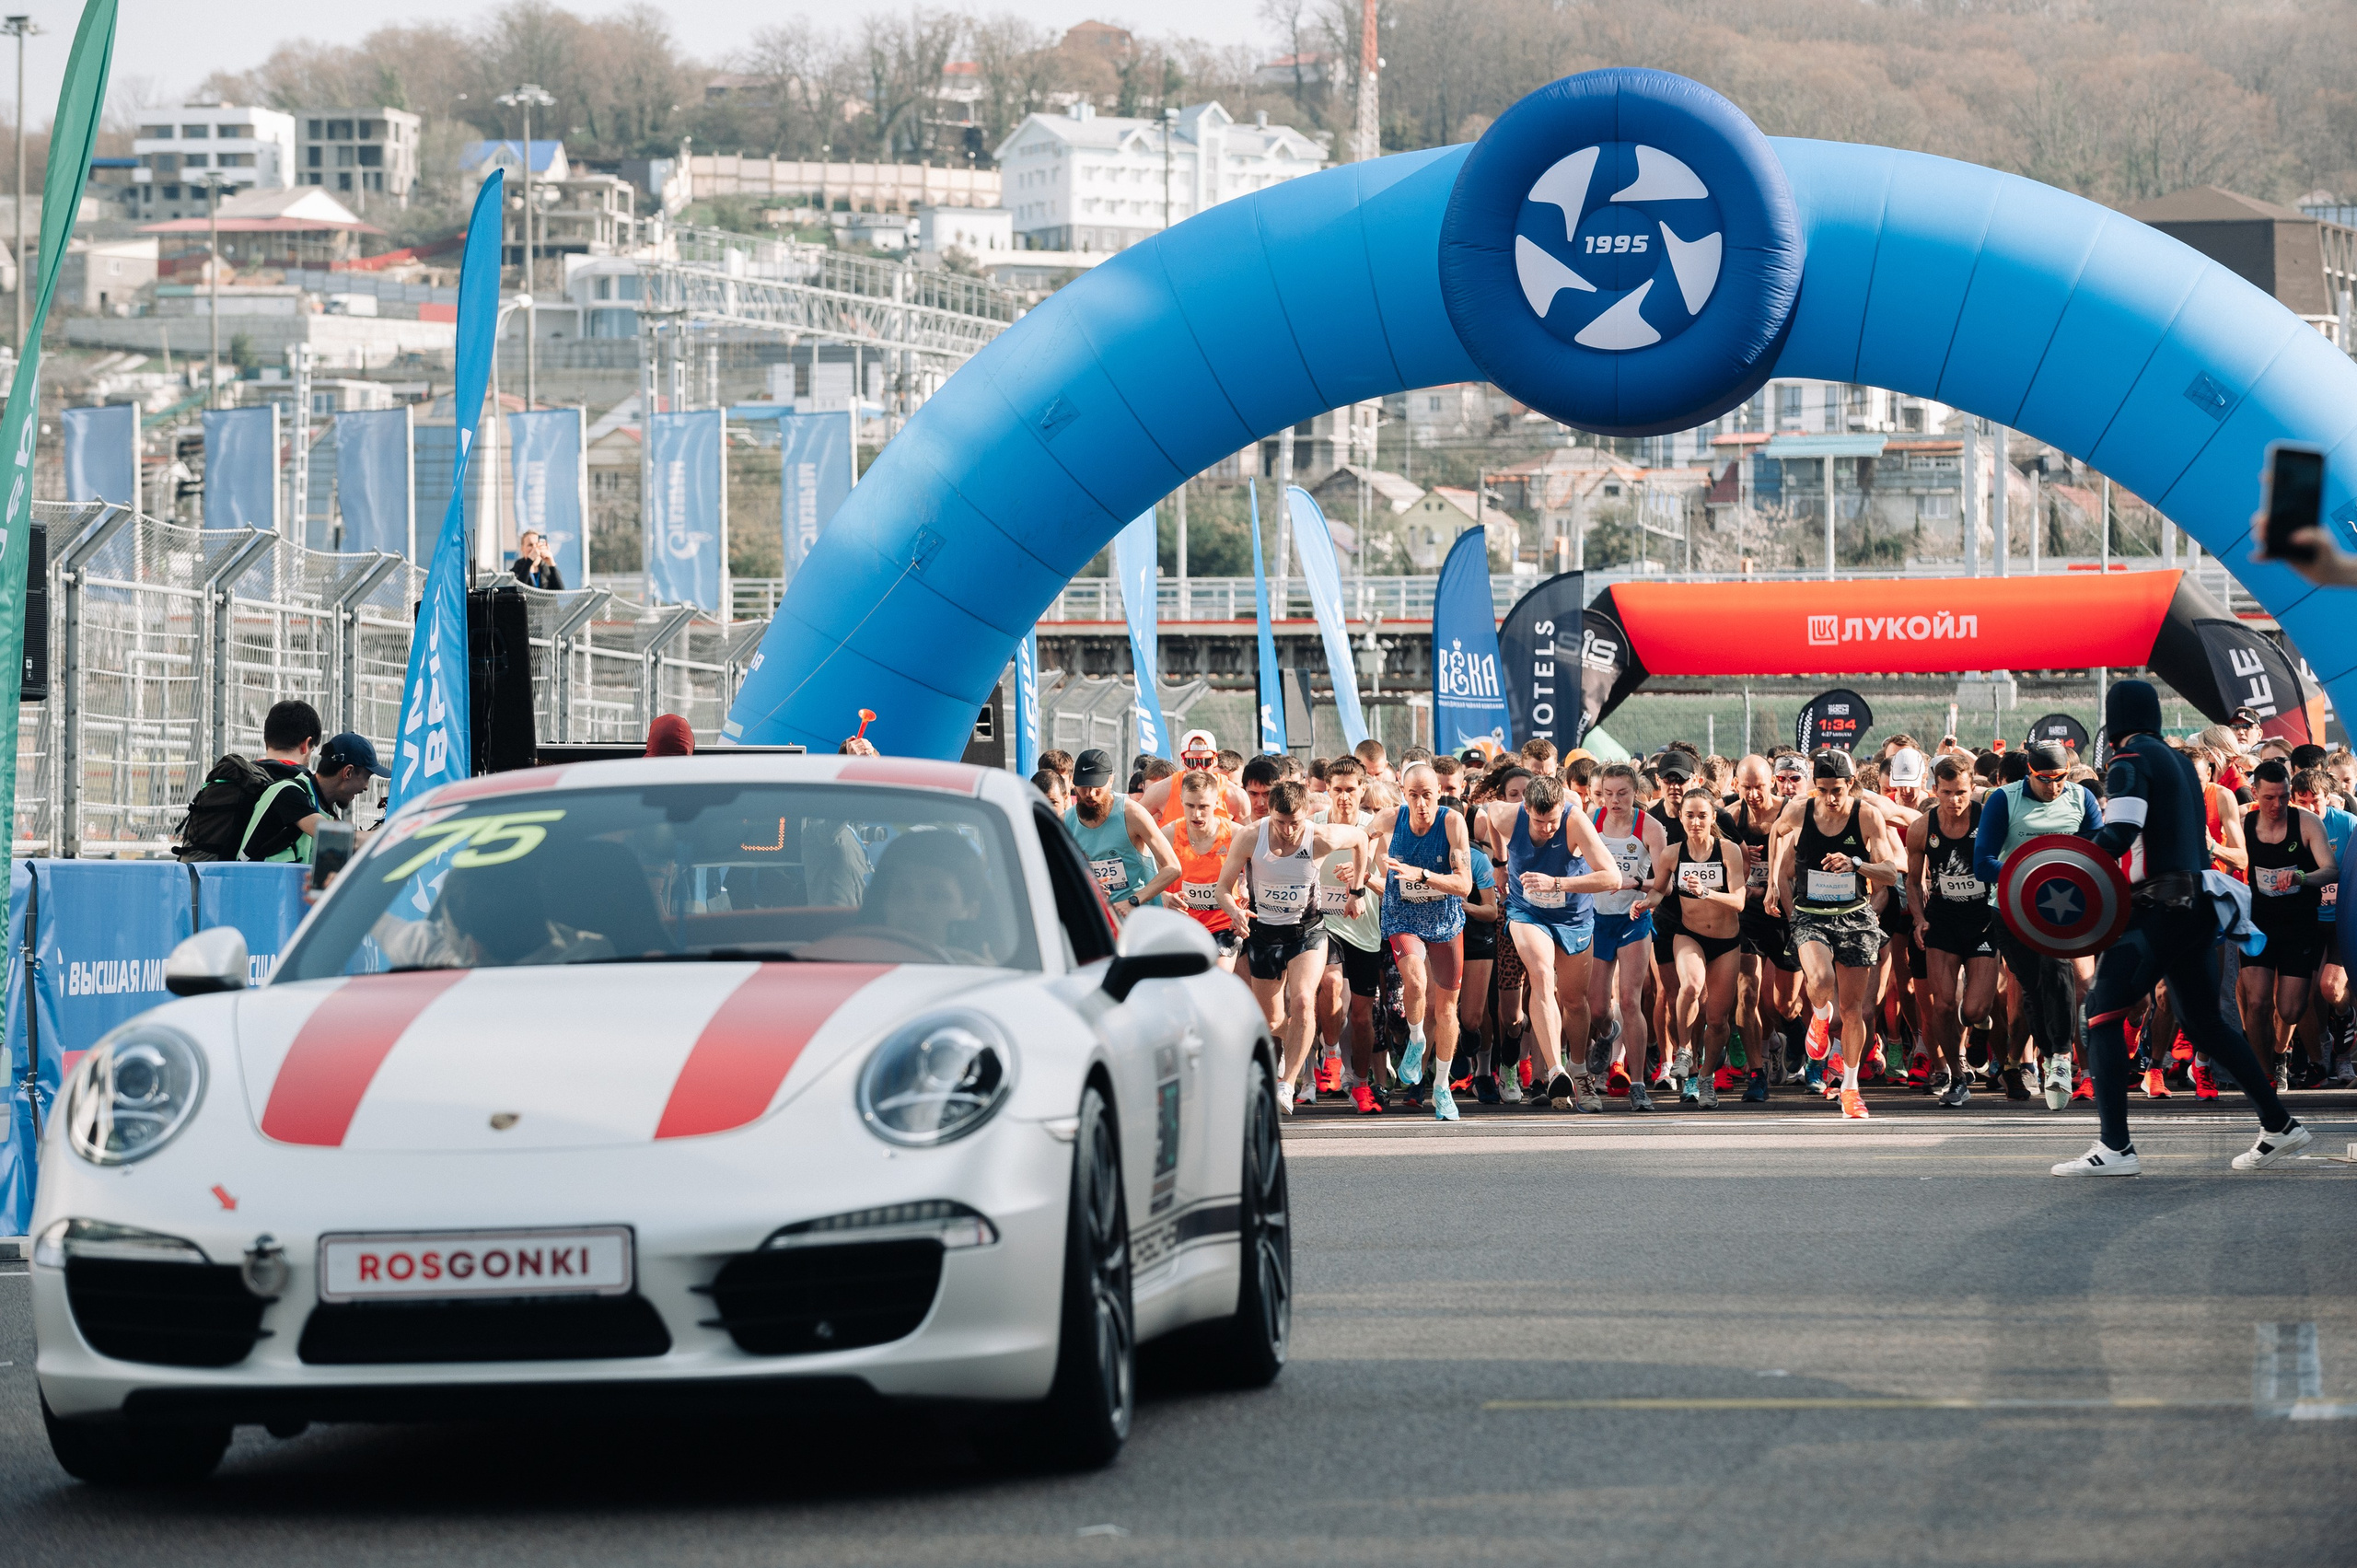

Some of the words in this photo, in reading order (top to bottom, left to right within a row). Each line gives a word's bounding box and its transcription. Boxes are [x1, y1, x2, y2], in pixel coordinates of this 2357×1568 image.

[1585, 235, 1649, 254] 1995
[1841, 610, 1979, 642] ЛУКОЙЛ
[1818, 718, 1857, 731] 1:34
[382, 808, 567, 884] 75
[1093, 866, 1118, 878] 525
[1405, 881, 1436, 890] 863
[1947, 880, 1975, 890] 9119
[1264, 889, 1298, 901] 7520
[68, 959, 140, 996] ВЫСШАЯ
[142, 958, 168, 993] ЛИГ
[357, 1246, 591, 1283] ROSGONKI
